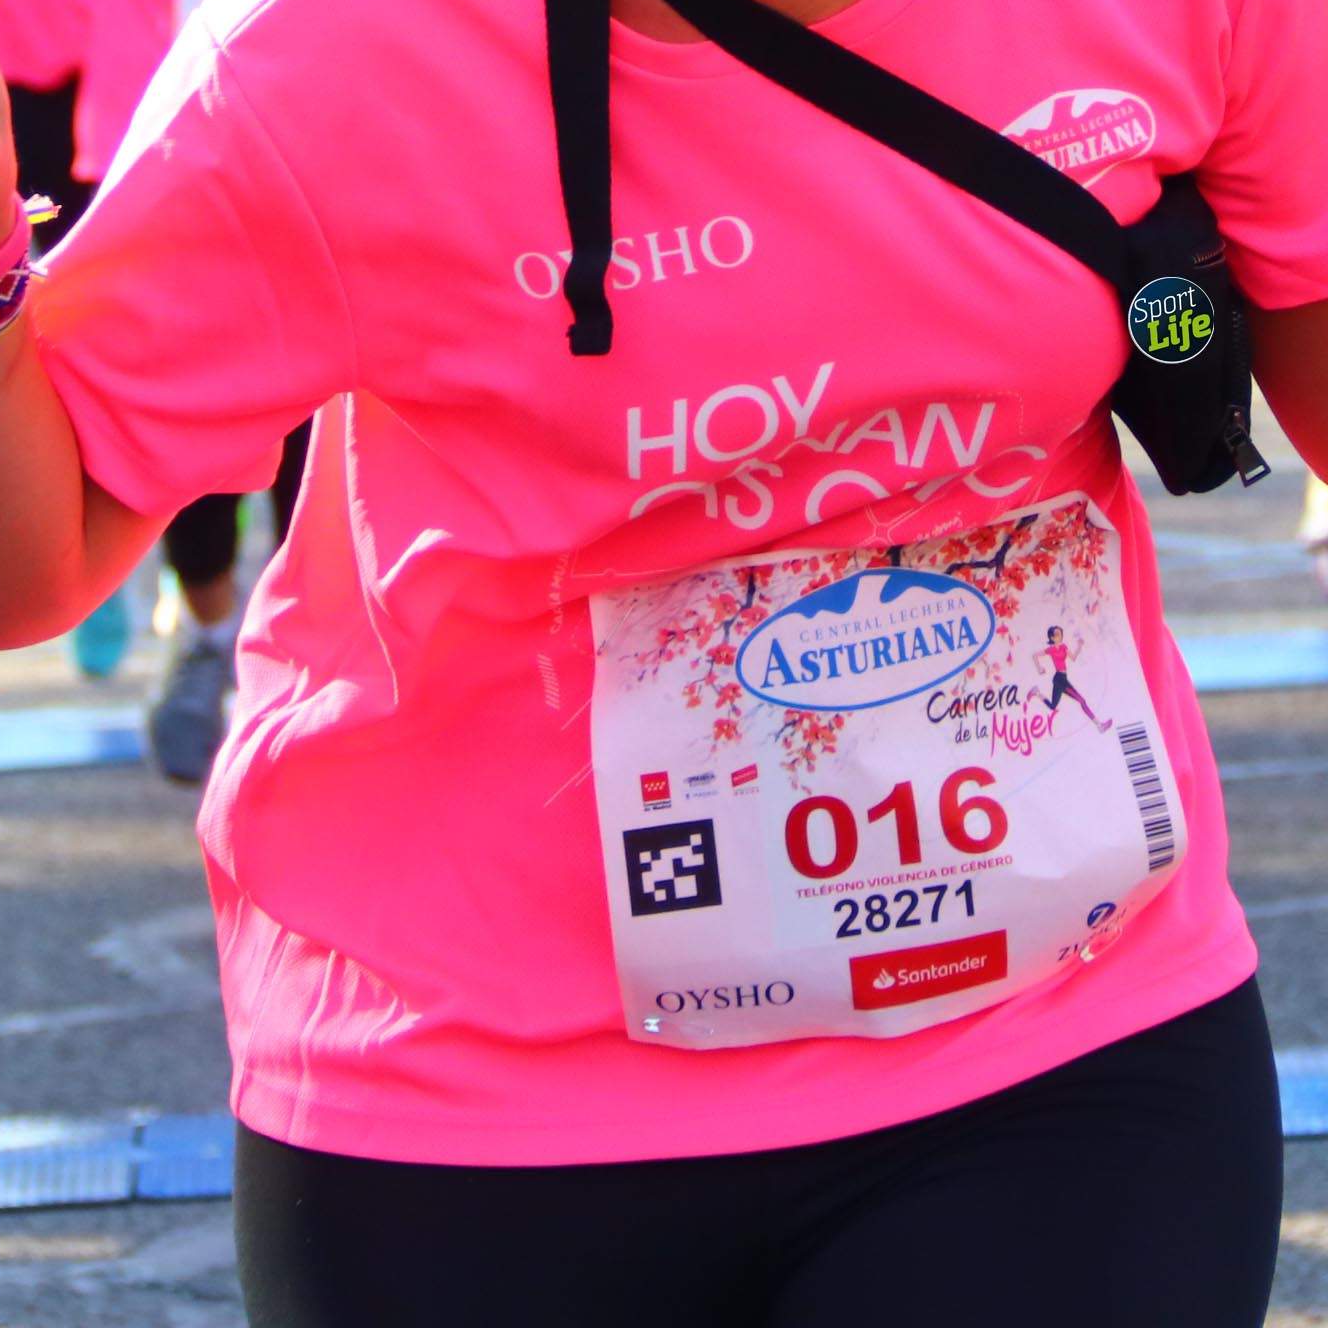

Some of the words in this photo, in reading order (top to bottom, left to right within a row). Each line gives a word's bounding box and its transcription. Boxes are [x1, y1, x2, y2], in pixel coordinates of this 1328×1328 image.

[513, 215, 754, 300] OSHO
[626, 361, 835, 480] HOY
[799, 616, 883, 643] CENTRAL
[890, 597, 967, 624] LECHERA
[760, 615, 980, 689] ASTURIANA
[927, 684, 1021, 723] Carrera
[955, 720, 971, 744] de
[976, 717, 988, 739] la
[991, 701, 1060, 758] Mujer
[784, 766, 1009, 880] 016
[867, 869, 938, 889] VIOLENCIA
[940, 865, 958, 878] DE
[833, 879, 975, 939] 28271
[655, 980, 795, 1014] OYSHO
[897, 953, 988, 987] Santander
